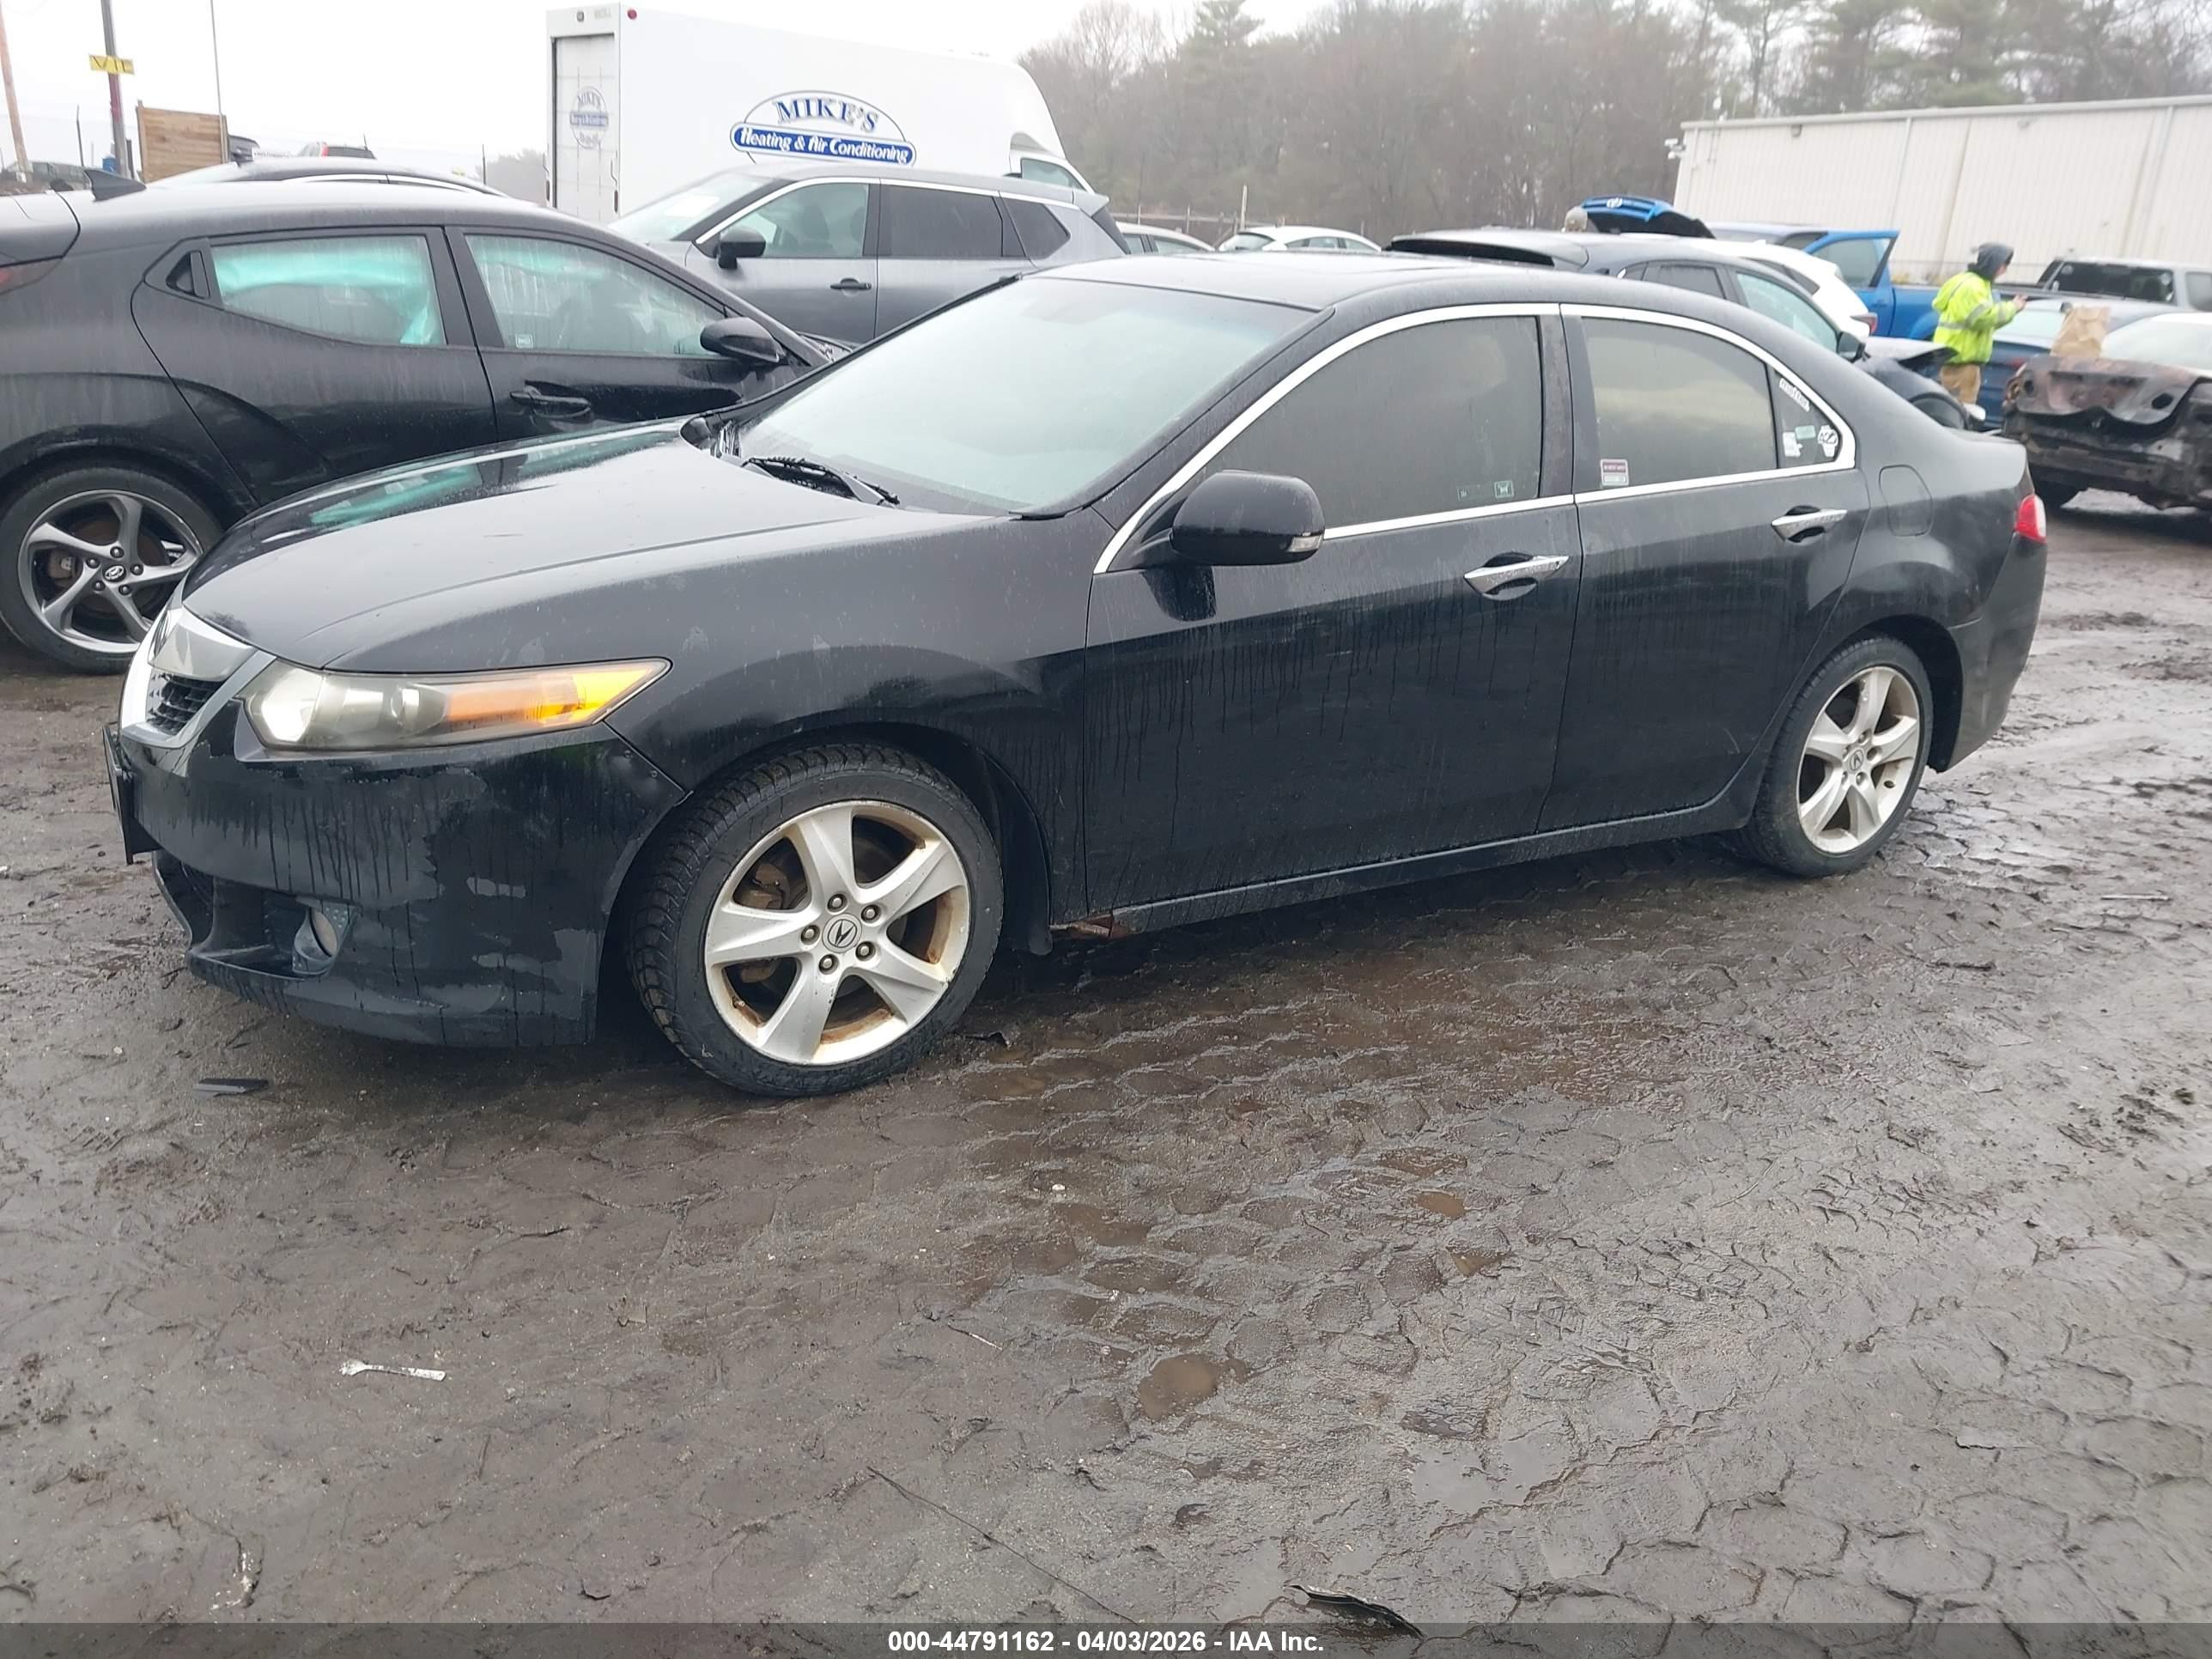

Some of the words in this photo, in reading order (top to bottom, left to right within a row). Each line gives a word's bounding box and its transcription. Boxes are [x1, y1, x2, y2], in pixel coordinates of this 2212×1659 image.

[773, 96, 879, 132] MIKE'S
[740, 127, 792, 152] Heating
[794, 135, 805, 150] &
[808, 137, 829, 154] Air
[830, 138, 909, 166] Conditioning
